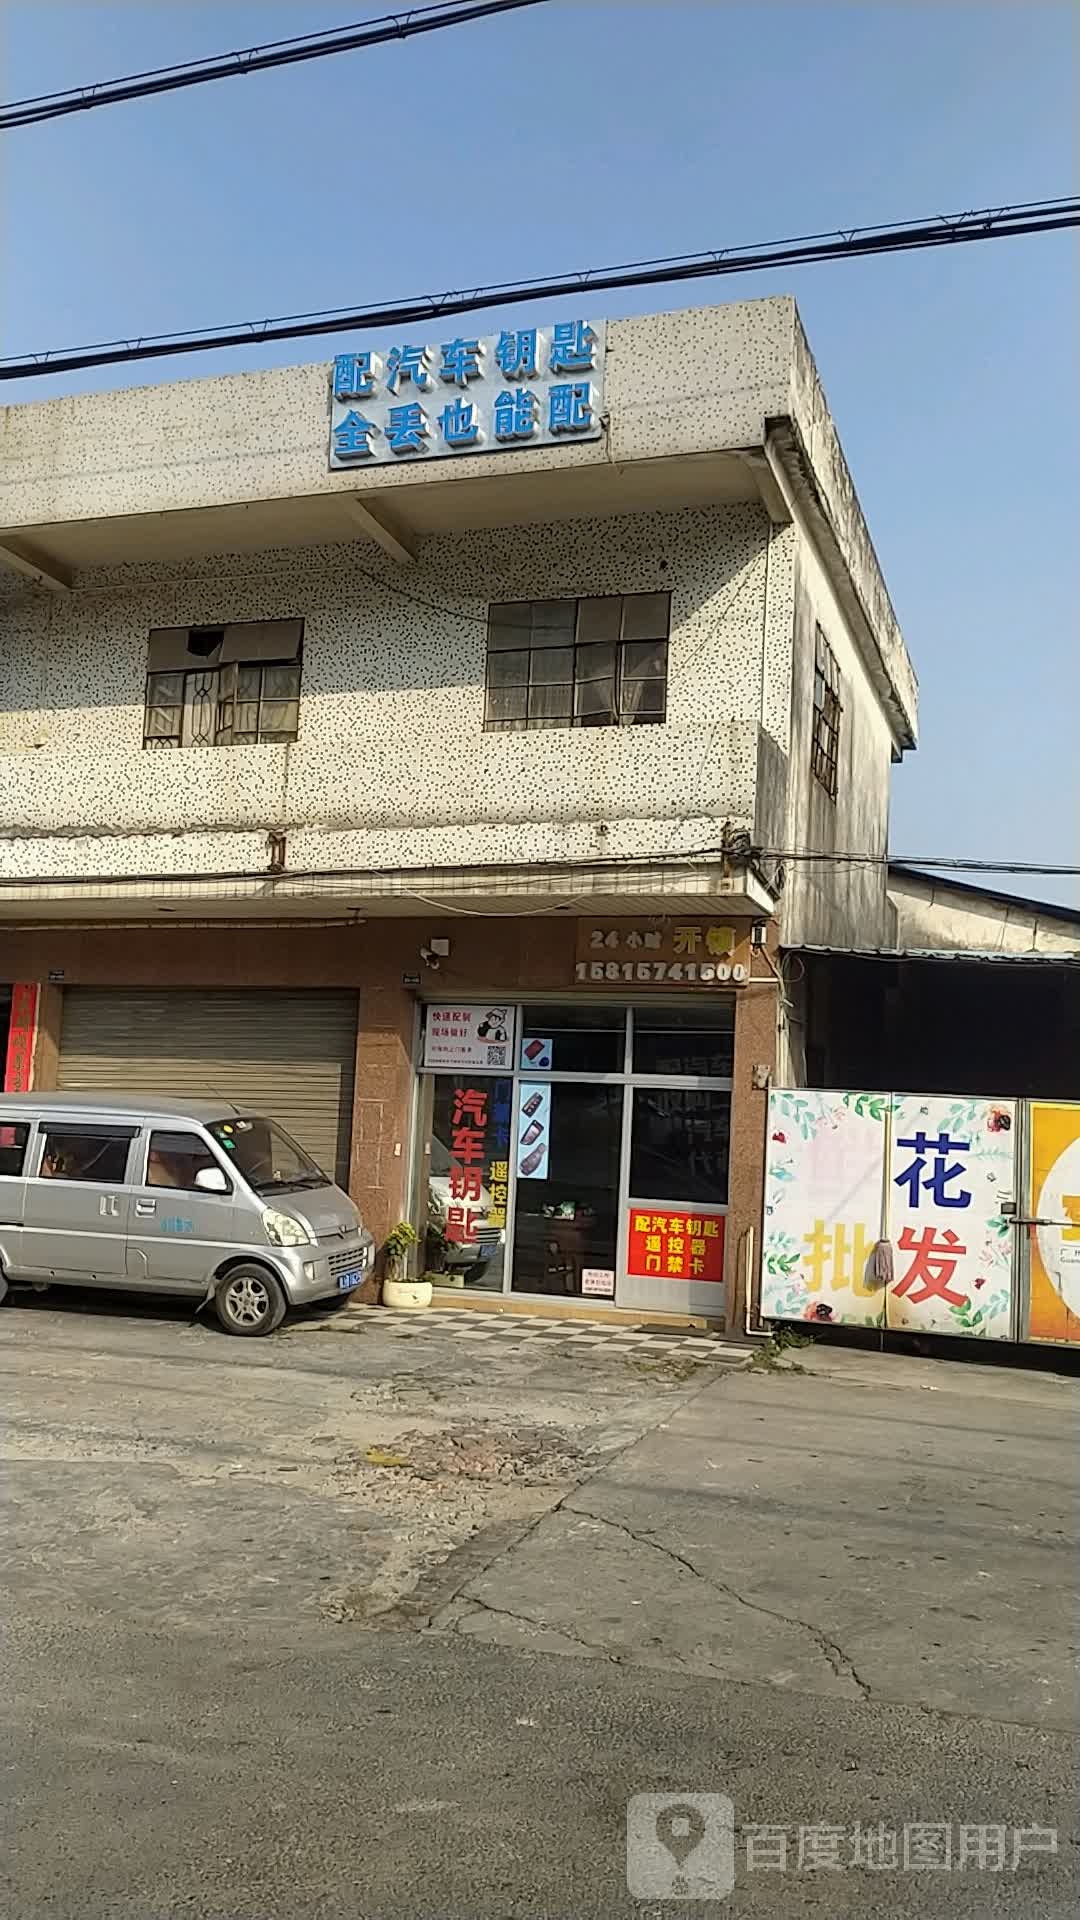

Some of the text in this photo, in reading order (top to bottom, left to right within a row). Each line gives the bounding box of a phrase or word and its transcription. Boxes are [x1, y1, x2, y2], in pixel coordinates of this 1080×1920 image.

[333, 320, 595, 400] 配汽车钥匙
[333, 382, 595, 456] 全丢也能配
[446, 1088, 488, 1244] 汽车钥匙
[487, 1161, 508, 1228] 遥控器
[634, 1215, 719, 1238] 配汽车钥匙
[645, 1235, 706, 1256] 遥控器
[645, 1255, 705, 1275] 门禁卡
[802, 1219, 969, 1307] 批发
